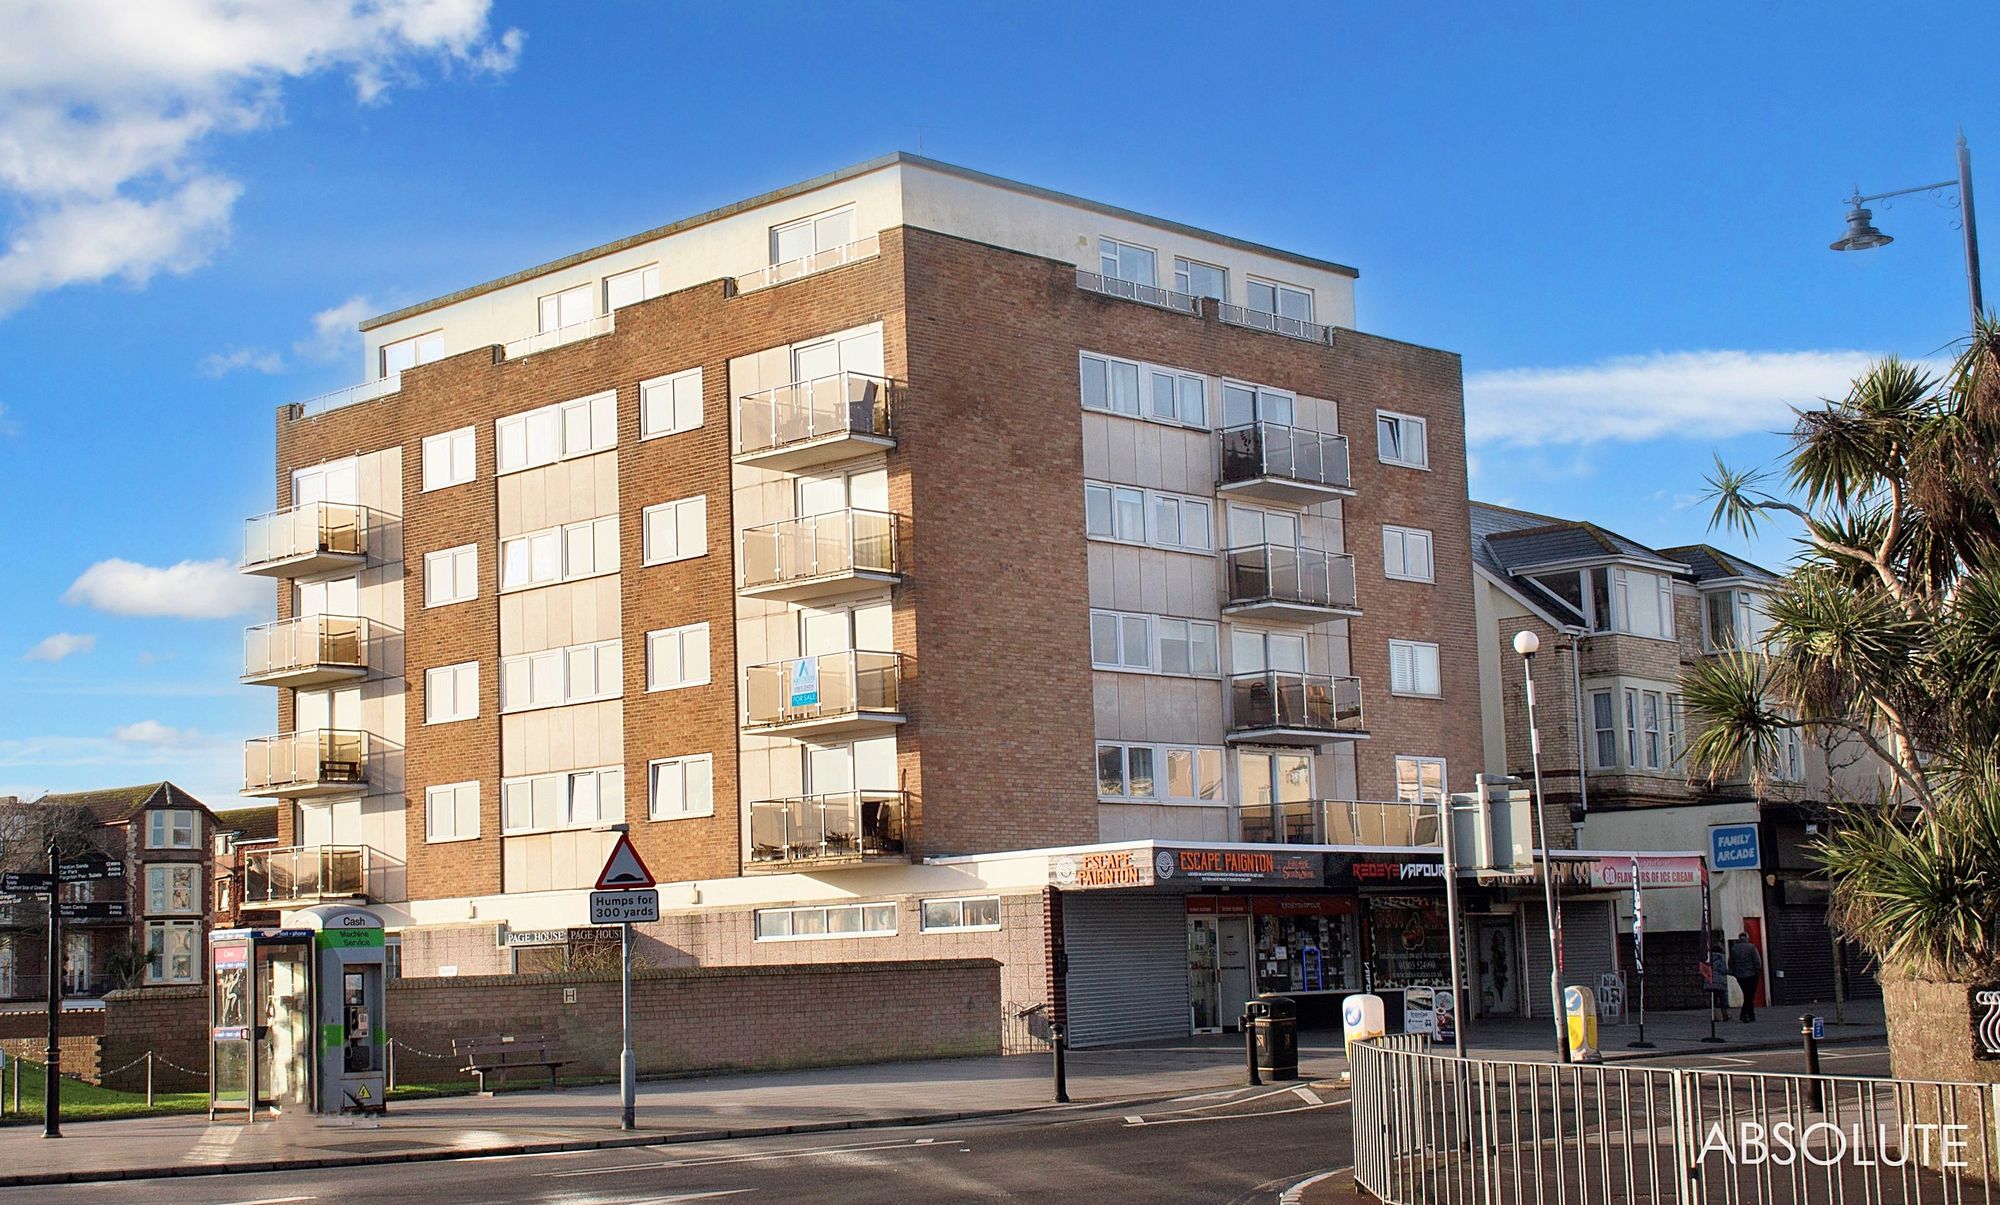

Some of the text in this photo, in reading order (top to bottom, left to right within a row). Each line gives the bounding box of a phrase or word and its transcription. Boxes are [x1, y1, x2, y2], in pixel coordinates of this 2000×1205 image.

[1718, 833, 1751, 848] FAMILY
[1083, 852, 1134, 870] ESCAPE
[1180, 851, 1222, 871] ESCAPE
[1224, 852, 1274, 873] PAIGNTON
[1717, 847, 1755, 863] ARCADE
[1077, 867, 1140, 886] PAIGNTON
[1604, 868, 1694, 883] 80 FLAVRS OF ICE CREAM
[596, 894, 653, 908] Humps for
[596, 906, 654, 919] 300 yards
[343, 916, 366, 927] Cash
[508, 931, 564, 944] PAGE HOUSE
[570, 928, 622, 940] PAGE HOUS
[565, 989, 575, 1002] H
